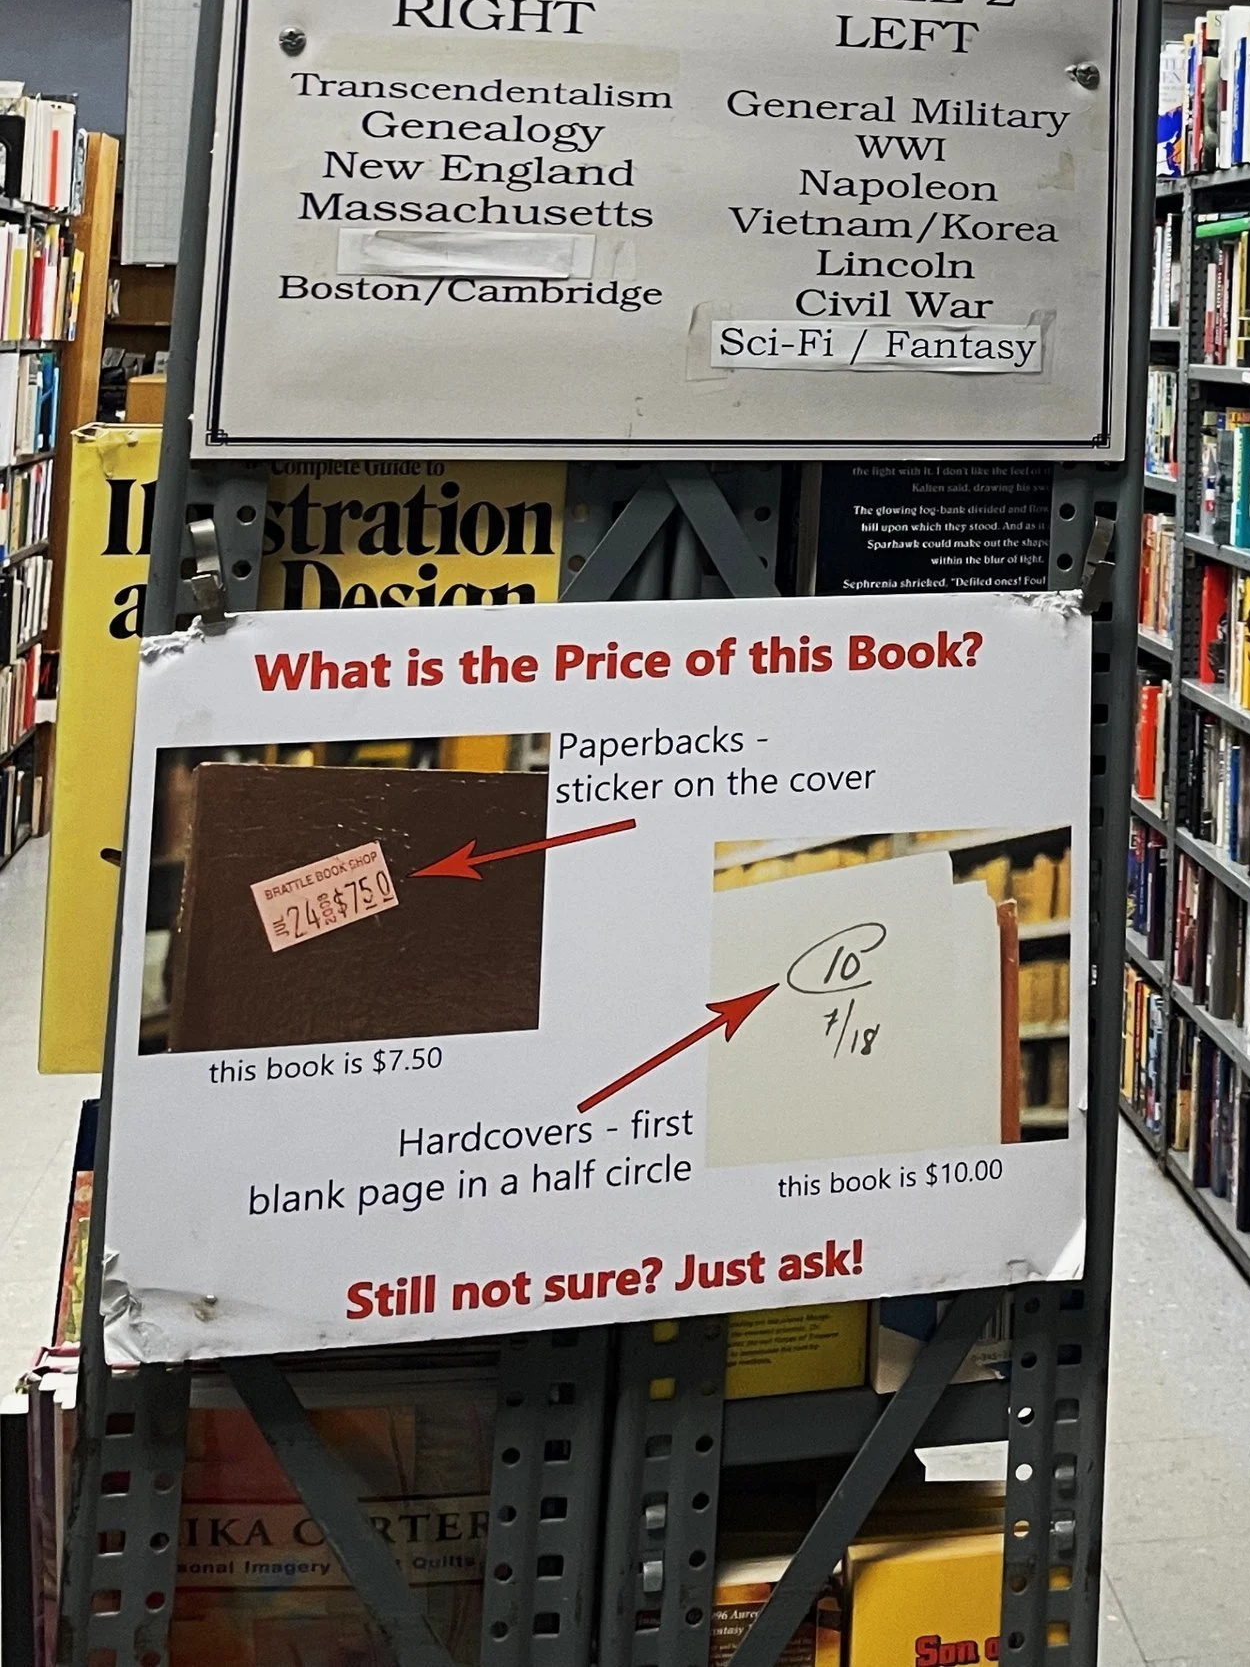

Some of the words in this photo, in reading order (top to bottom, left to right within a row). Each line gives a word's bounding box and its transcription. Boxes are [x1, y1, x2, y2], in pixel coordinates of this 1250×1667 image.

[836, 15, 979, 53] LEFT
[291, 73, 672, 108] Transcendentalism
[363, 111, 605, 152] Genealogy
[728, 90, 895, 122] General
[912, 98, 1070, 137] Military
[855, 135, 946, 161] WWI
[323, 151, 424, 179] New
[440, 155, 633, 192] England
[800, 169, 998, 205] Napoleon
[299, 193, 652, 227] Massachusetts
[728, 207, 1059, 243] Vietnam/Korea
[817, 250, 975, 279] Lincoln
[279, 274, 662, 312] Boston/Cambridge
[796, 289, 891, 317] Civil
[905, 292, 993, 319] War
[721, 328, 833, 356] Sci-Fi
[885, 328, 1036, 367] Fantasy
[854, 506, 873, 515] The
[876, 507, 917, 517] glowing
[920, 505, 965, 517] fog-bank
[867, 539, 920, 550] Sparhawk
[922, 539, 951, 548] could
[954, 539, 981, 548] make
[984, 539, 1000, 547] out
[1003, 538, 1019, 547] the
[931, 556, 962, 565] within
[966, 556, 981, 564] the
[984, 555, 1004, 564] blur
[1008, 555, 1017, 563] of
[843, 579, 897, 589] Sephrenia
[256, 651, 389, 690] What
[408, 649, 442, 685] is
[461, 646, 537, 684] the
[556, 643, 670, 680] Price
[686, 638, 735, 676] of
[750, 638, 831, 674] this
[849, 632, 981, 670] Book?
[560, 726, 743, 765] Paperbacks
[556, 773, 663, 803] sticker
[675, 778, 713, 797] on
[727, 768, 777, 795] the
[790, 770, 876, 792] cover
[264, 874, 314, 900] BRATTLE
[317, 864, 347, 882] BOOK
[350, 851, 377, 869] SHOP
[287, 901, 320, 938] 24
[824, 946, 860, 984] 10
[209, 1060, 255, 1083] this
[267, 1054, 334, 1080] book
[345, 1052, 362, 1074] is
[373, 1047, 442, 1074] $7.50
[400, 1122, 591, 1157] Hardcovers
[631, 1110, 693, 1139] first
[250, 1179, 344, 1215] blank
[359, 1180, 444, 1215] page
[459, 1170, 486, 1198] in
[501, 1174, 517, 1195] a
[533, 1159, 596, 1192] half
[607, 1154, 691, 1186] circle
[778, 1174, 820, 1197] this
[831, 1168, 891, 1193] book
[901, 1167, 916, 1187] is
[926, 1159, 1002, 1187] $10.00
[348, 1277, 434, 1318] Still
[453, 1274, 528, 1309] not
[547, 1258, 661, 1301] sure?
[677, 1253, 763, 1289] Just
[779, 1242, 861, 1280] ask!
[245, 1560, 330, 1576] Imagery
[412, 1556, 475, 1569] Quilts
[915, 1635, 979, 1667] Son
